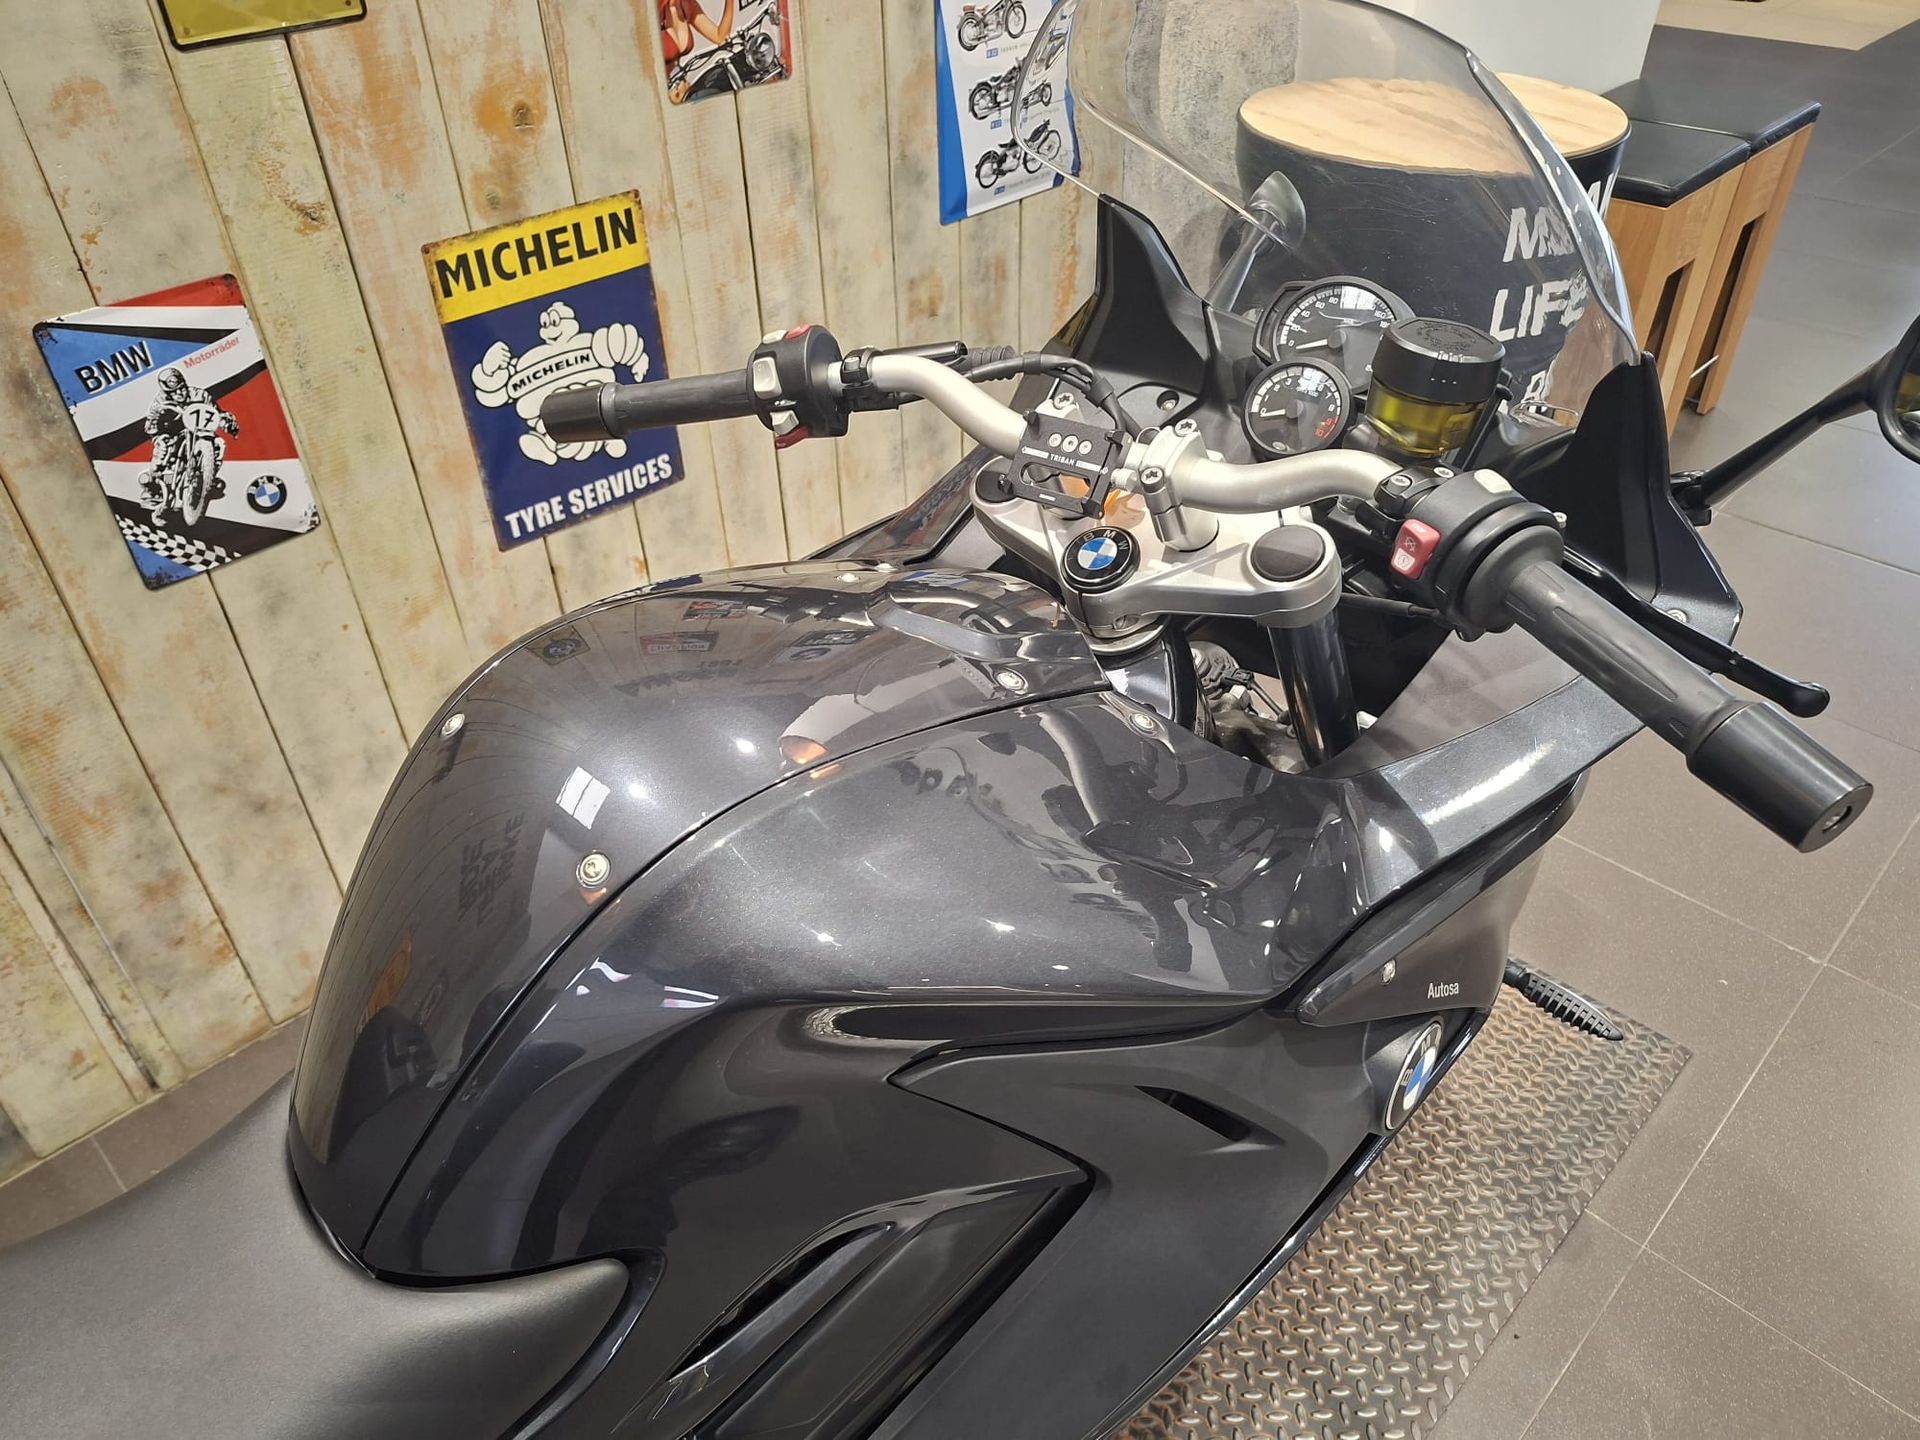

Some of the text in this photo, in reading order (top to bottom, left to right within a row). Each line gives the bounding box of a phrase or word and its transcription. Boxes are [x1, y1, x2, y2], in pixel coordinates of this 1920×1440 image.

[434, 207, 638, 299] MICHELIN
[74, 341, 154, 394] BMW
[183, 336, 240, 369] Motorräder
[511, 353, 591, 392] MICHELIN
[188, 408, 215, 428] 17
[504, 453, 673, 539] TYRE SERVICES
[1083, 529, 1129, 551] BMW
[1427, 982, 1460, 999] Autosa
